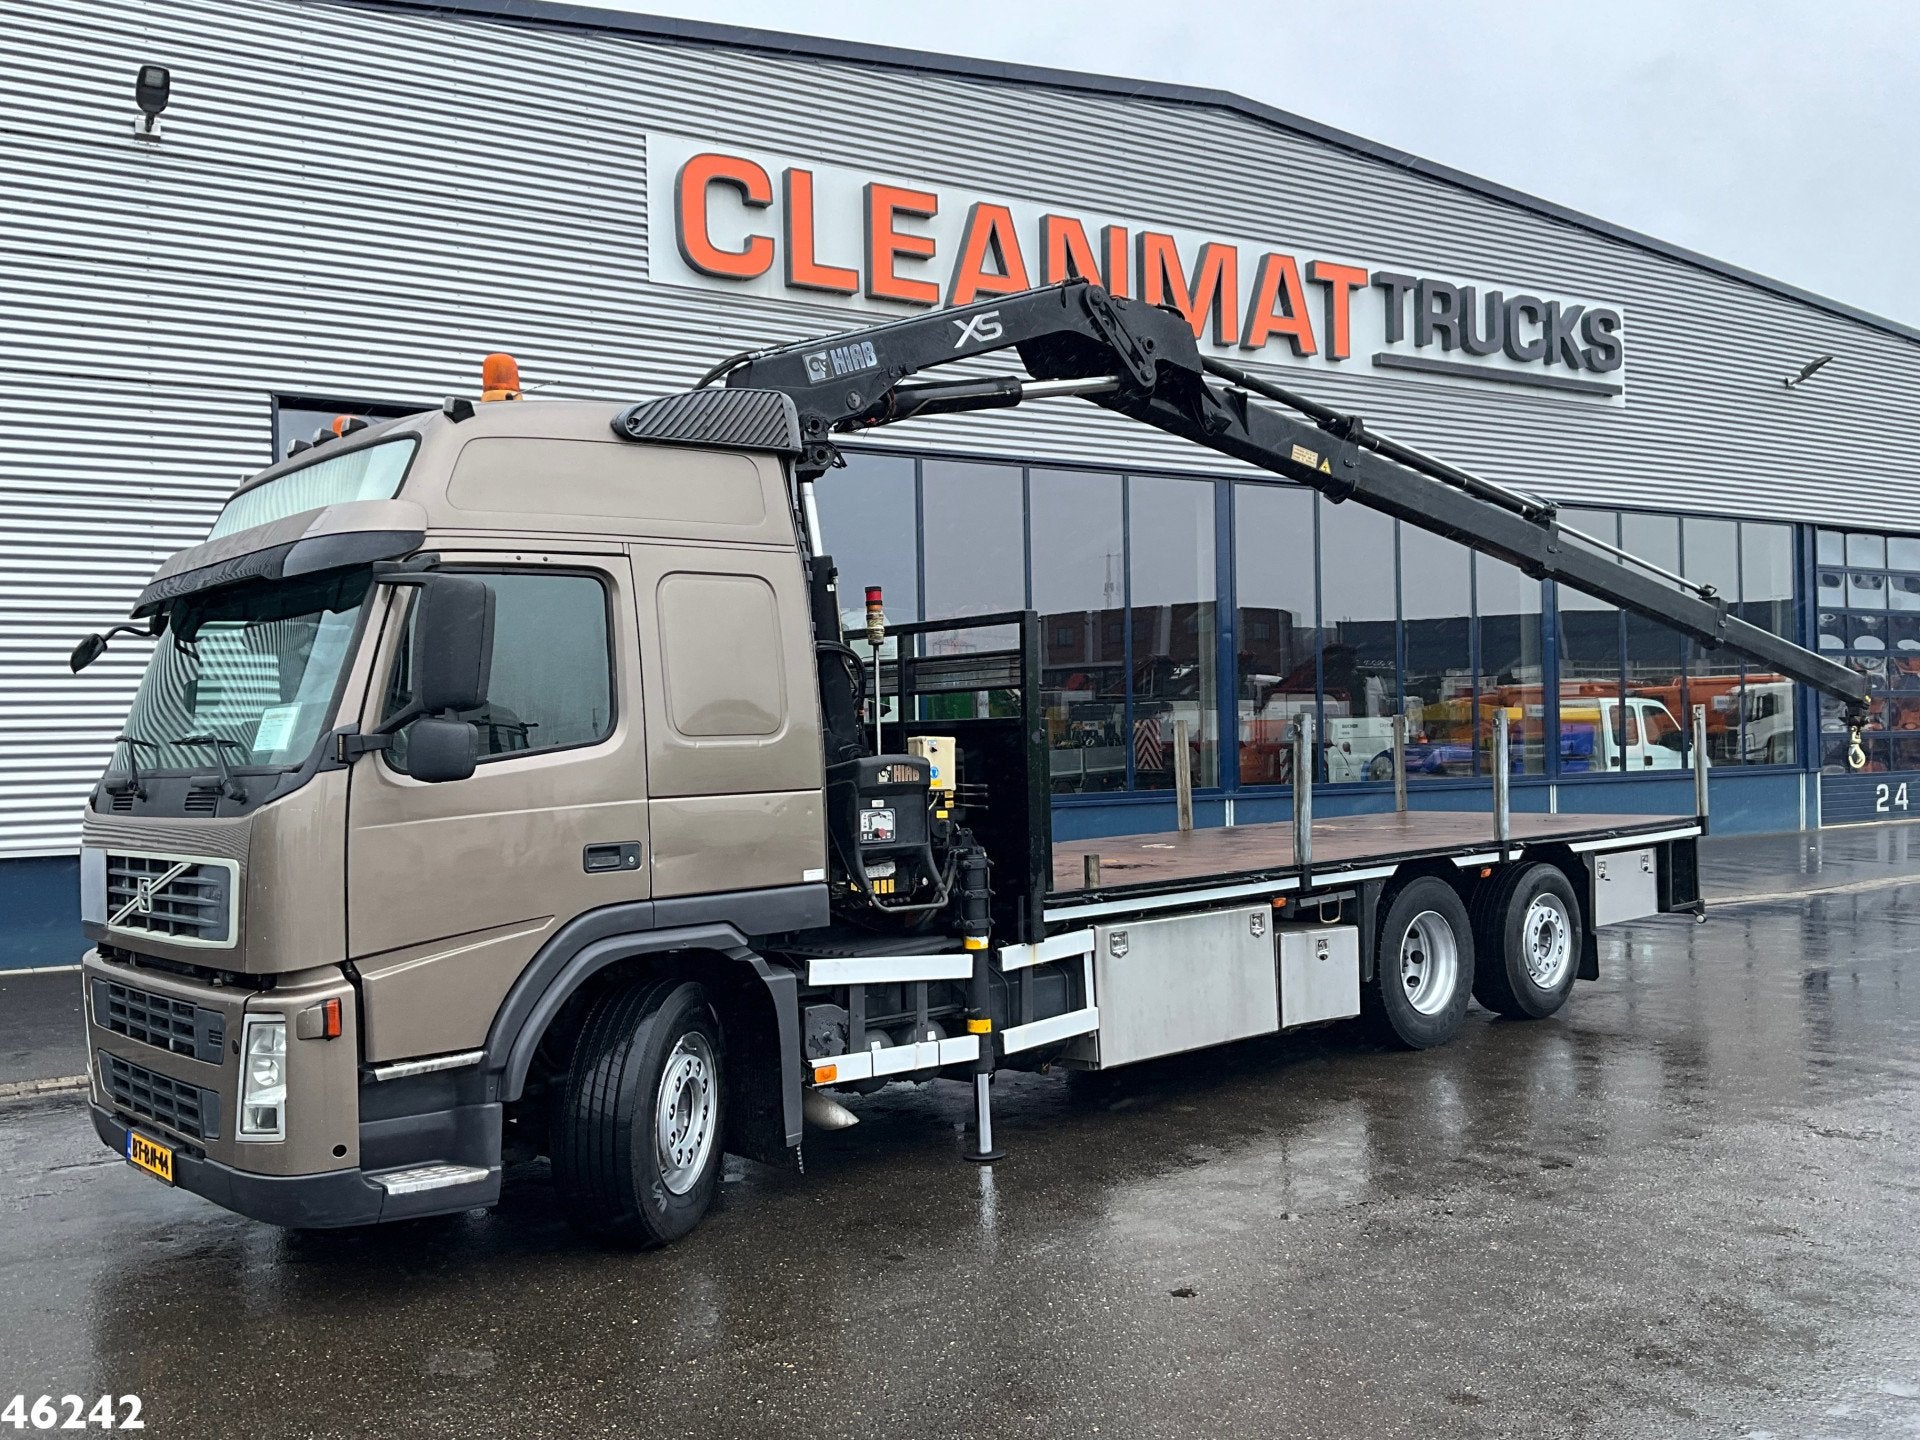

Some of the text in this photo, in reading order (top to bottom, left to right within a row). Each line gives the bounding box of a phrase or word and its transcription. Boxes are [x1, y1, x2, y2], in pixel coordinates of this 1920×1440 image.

[675, 153, 1623, 373] CLEANMAT TRUCKS
[952, 310, 1003, 349] XS
[829, 341, 878, 375] HIAB
[893, 764, 920, 782] HIAB
[1876, 782, 1909, 812] 24
